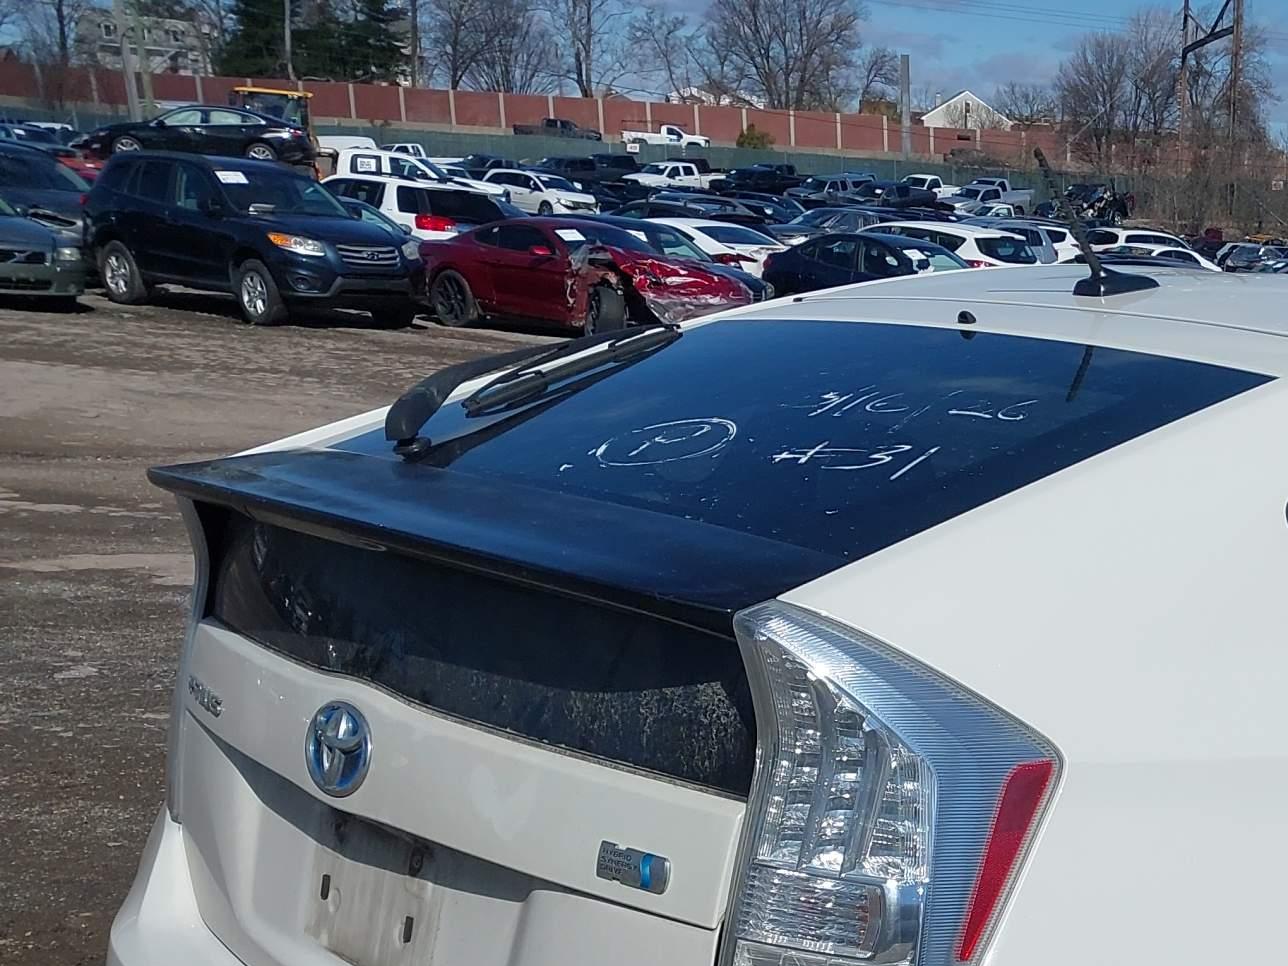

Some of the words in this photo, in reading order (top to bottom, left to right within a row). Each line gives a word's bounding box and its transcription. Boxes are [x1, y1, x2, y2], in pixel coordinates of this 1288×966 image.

[771, 440, 942, 481] #31
[602, 847, 633, 862] HYBRID
[600, 856, 638, 871] SYNERGY
